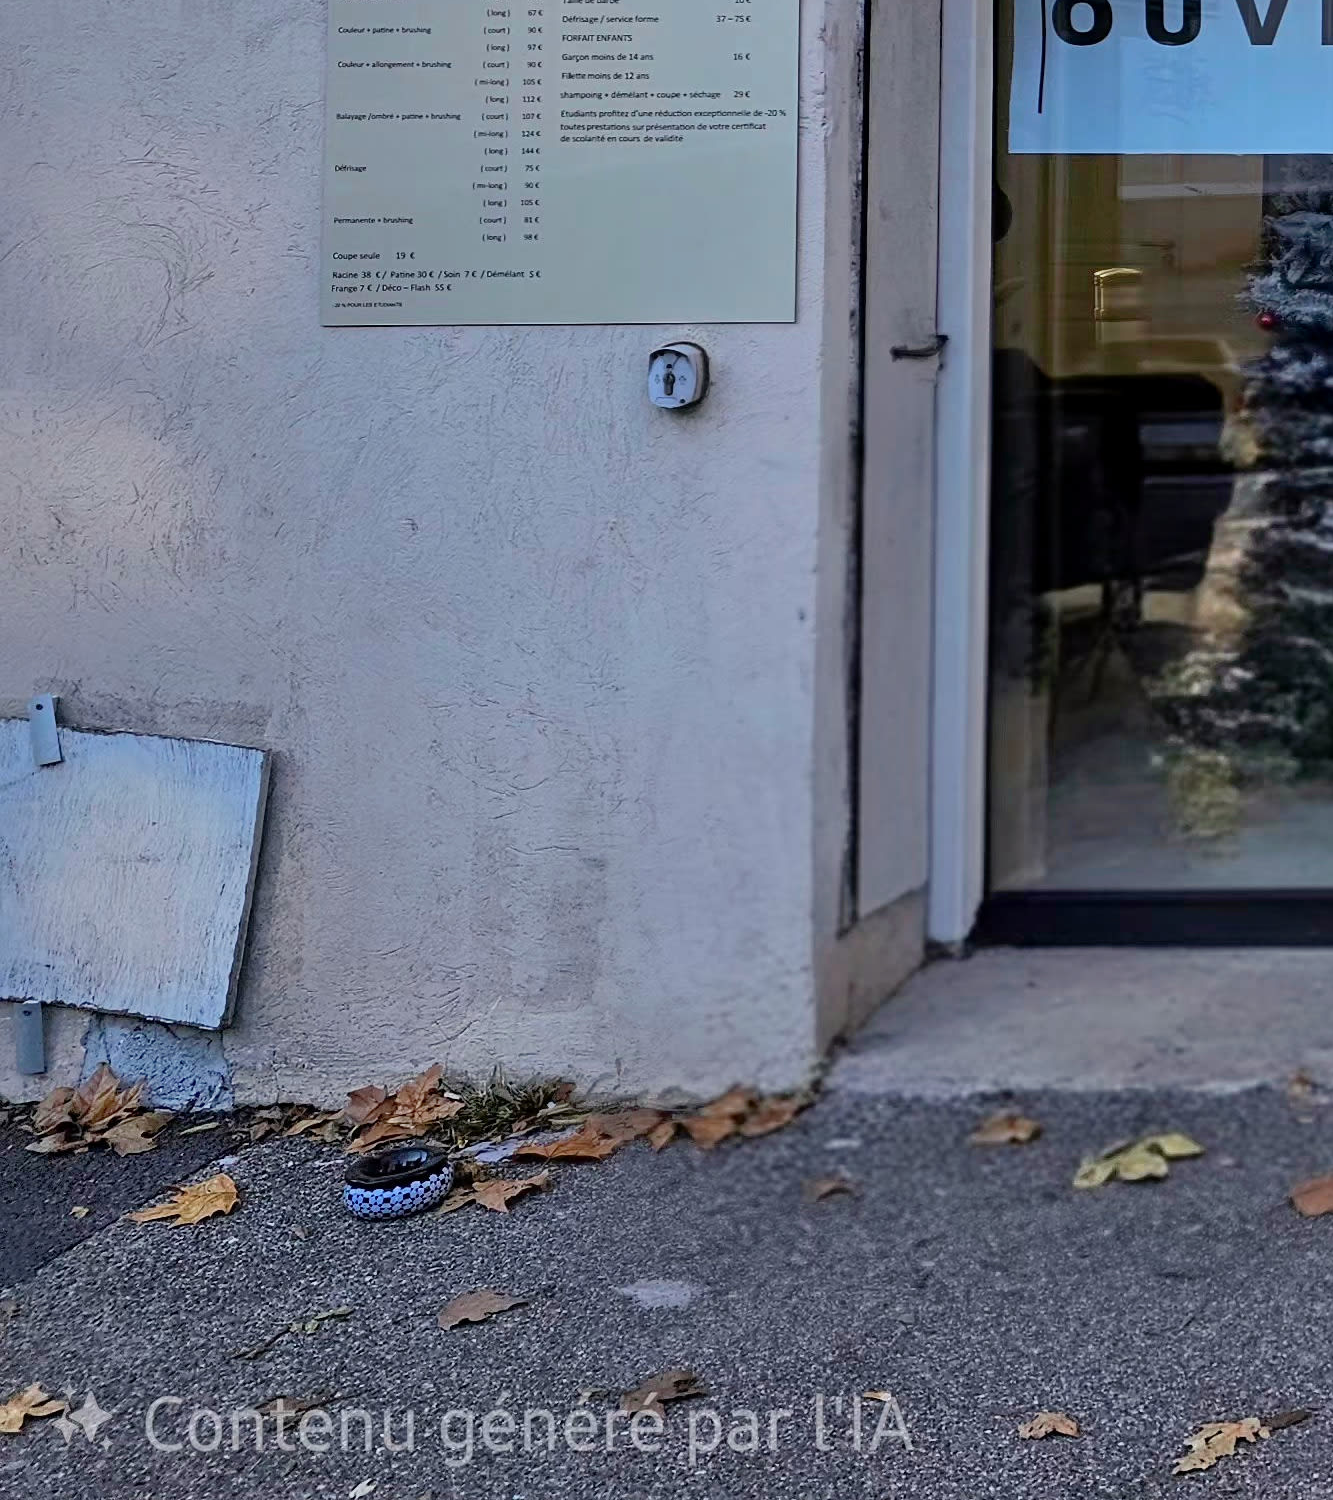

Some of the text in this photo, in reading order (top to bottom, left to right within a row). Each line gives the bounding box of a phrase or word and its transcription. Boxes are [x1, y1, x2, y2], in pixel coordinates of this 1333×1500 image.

[634, 15, 660, 23] forme
[715, 15, 745, 23] 37 75
[337, 26, 432, 35] Couleur patine brushing
[561, 34, 633, 42] FORFAIT ENFANTS
[527, 43, 537, 51] 97
[561, 53, 590, 63] Garçon
[616, 52, 627, 61] de
[629, 53, 639, 61] 14
[733, 53, 744, 61] 16
[337, 60, 452, 69] Couleur allongement brushing
[561, 72, 587, 80] Fillette
[587, 73, 612, 81] moins
[612, 72, 623, 80] de
[624, 71, 635, 80] 12
[522, 78, 536, 86] 105
[559, 91, 603, 101] shampoing
[733, 90, 744, 99] 29
[522, 95, 536, 103] 112
[401, 113, 424, 121] patine
[430, 113, 461, 121] brushing
[521, 112, 535, 120] 107
[598, 109, 629, 119] profitez
[654, 109, 693, 117] réduction
[752, 109, 763, 117] de
[559, 123, 587, 131] toutes
[586, 123, 631, 132] prestations
[645, 123, 696, 133] présentation
[696, 123, 708, 131] de
[708, 123, 731, 131] votre
[731, 122, 767, 131] certificat
[521, 130, 535, 138] 124
[559, 135, 571, 143] de
[571, 135, 606, 143] scolarité
[643, 135, 654, 143] de
[654, 134, 685, 143] validité
[521, 147, 535, 155] 144
[525, 164, 535, 172] 75
[520, 199, 534, 207] 105
[382, 217, 414, 225] brushing
[332, 251, 381, 261] Coupe seule
[396, 251, 407, 260] 19
[332, 271, 359, 279] Racine
[361, 270, 372, 279] 38
[390, 270, 416, 279] Patine
[417, 270, 428, 279] 30
[443, 270, 461, 279] Soin
[463, 270, 470, 278] 7
[529, 270, 535, 279] 5
[331, 283, 445, 294] Frange 7 Déco Flash 55
